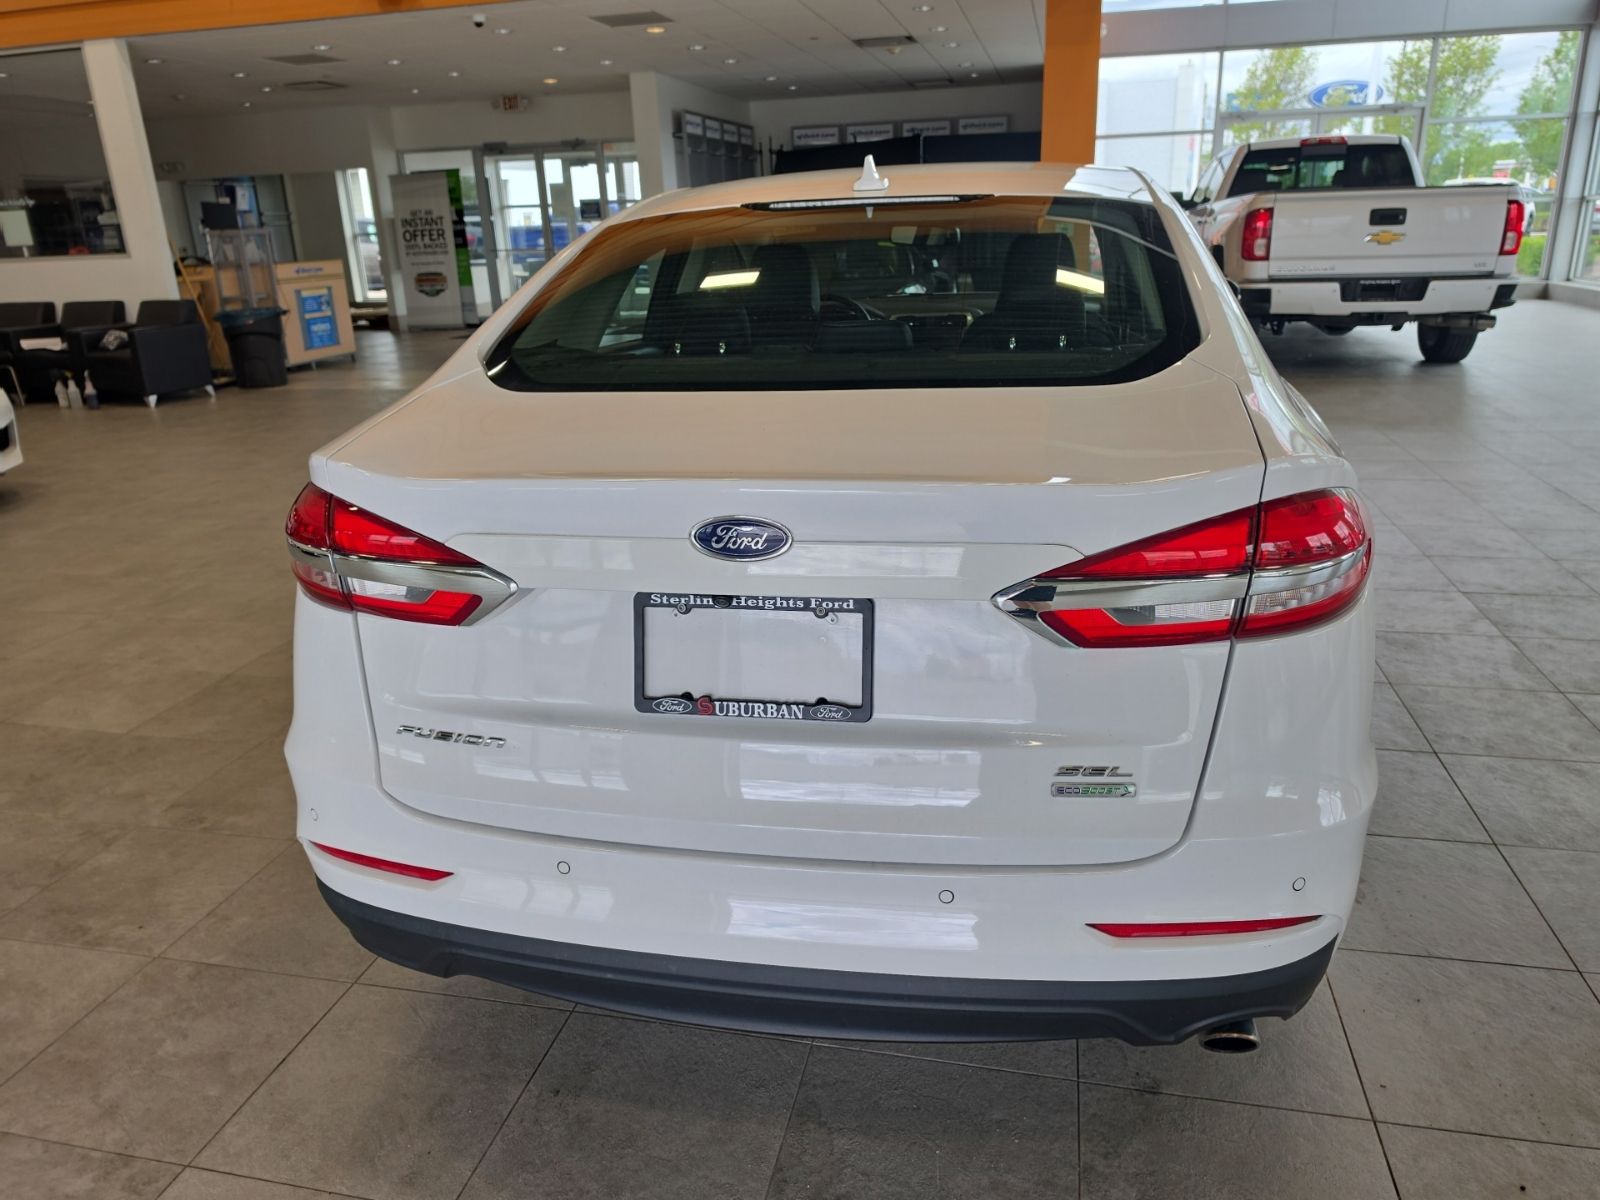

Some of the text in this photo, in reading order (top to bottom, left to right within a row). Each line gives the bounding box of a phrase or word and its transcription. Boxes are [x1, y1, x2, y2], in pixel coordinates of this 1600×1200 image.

[401, 216, 444, 229] INSTANT
[402, 228, 446, 242] OFFER
[711, 524, 768, 550] Ford
[650, 593, 854, 609] Sterlin Heights Ford
[697, 696, 804, 719] SUBURBAN
[396, 724, 507, 748] FUSION
[1054, 765, 1133, 777] SEL
